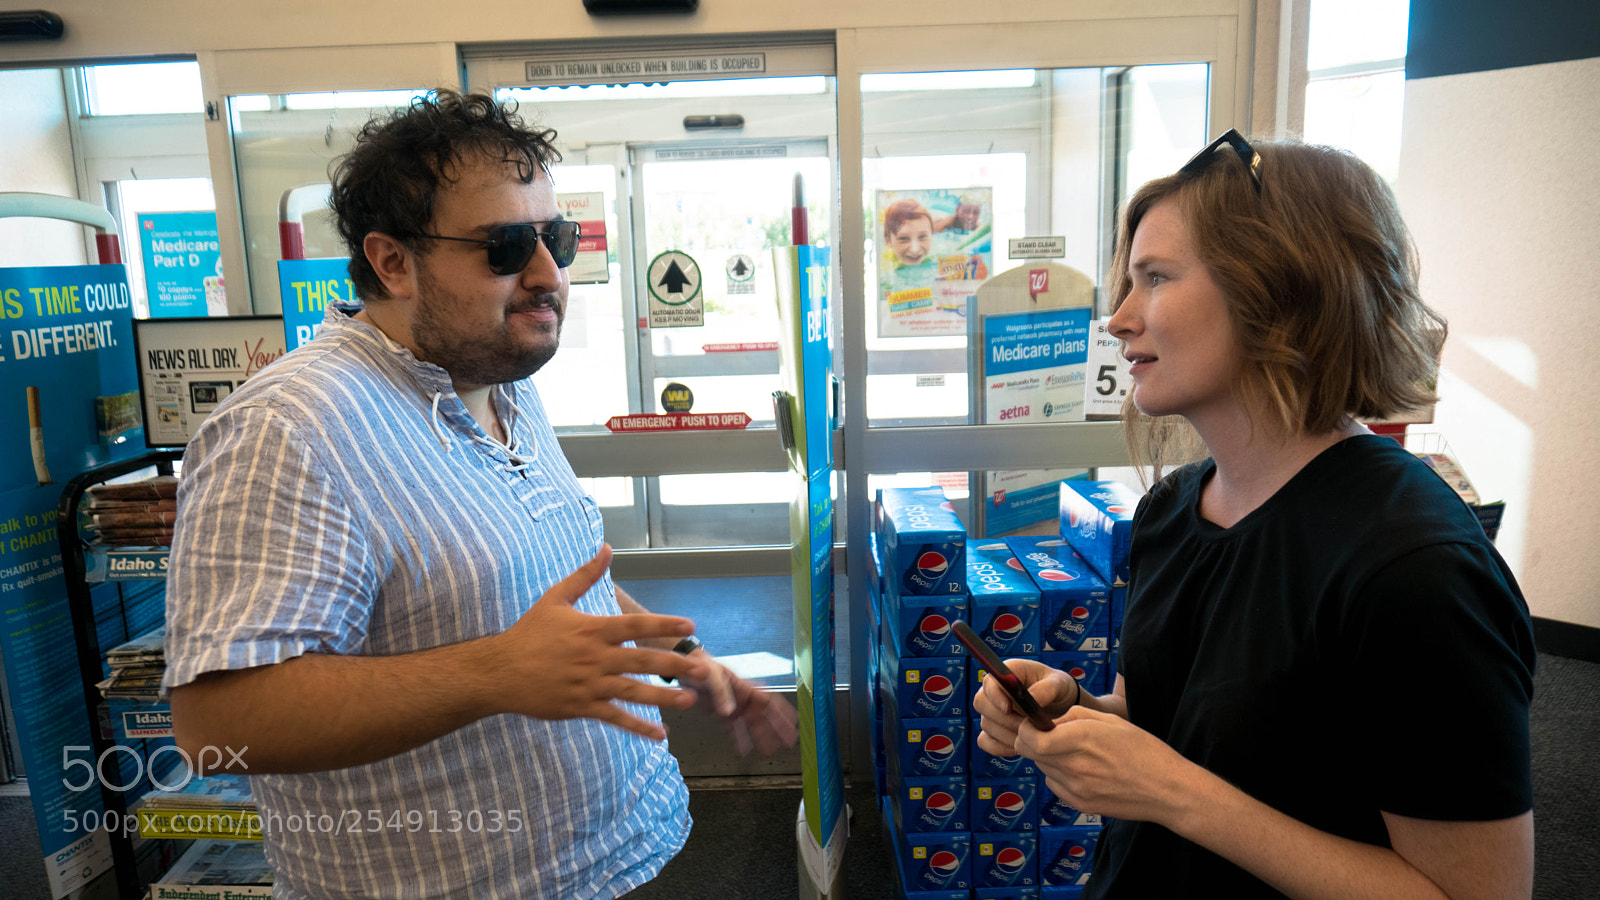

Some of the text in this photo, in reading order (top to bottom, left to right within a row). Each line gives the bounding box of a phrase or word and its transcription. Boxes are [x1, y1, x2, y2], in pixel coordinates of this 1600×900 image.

[531, 56, 760, 77] DOOR TO REMAIN UNLOCKED WHEN BUILDING IS OCCUPIED
[565, 198, 590, 210] you!
[151, 239, 219, 253] Medicare
[153, 253, 201, 268] Part D
[29, 285, 82, 317] TIME
[84, 282, 129, 312] COULD
[1006, 323, 1033, 332] Walgreens
[1034, 321, 1063, 330] participates
[11, 320, 118, 361] DIFFERENT.
[992, 334, 1017, 344] preferred
[1017, 331, 1038, 340] network
[1038, 329, 1063, 339] pharmacy
[992, 338, 1086, 363] Medicare plans
[148, 349, 186, 370] NEWS
[189, 349, 211, 369] ALL
[213, 348, 241, 369] DAY.
[1000, 404, 1031, 420] aetna
[610, 413, 746, 428] IN EMERGENCY PUSH TO OPEN
[905, 504, 939, 528] pepsi
[0, 517, 21, 534] alk
[25, 514, 38, 528] to
[0, 560, 40, 579] CHANTIX
[43, 557, 50, 567] is
[110, 557, 156, 571] Idaho
[910, 574, 934, 589] pepsi
[973, 560, 1014, 591] pepsi
[2, 582, 15, 593] Rx
[912, 636, 936, 650] pepsi
[984, 636, 1007, 650] pepsi
[917, 698, 939, 712] pepsi
[135, 713, 174, 724] Idaho
[919, 757, 941, 770] pepsi
[989, 758, 1011, 771] pepsi
[145, 813, 170, 827] THE
[175, 814, 215, 828] ARGUS
[921, 813, 941, 826] pepsi
[988, 813, 1009, 826] pepsi
[924, 872, 945, 884] pepsi
[990, 869, 1010, 881] pepsi
[158, 888, 221, 900] Independent
